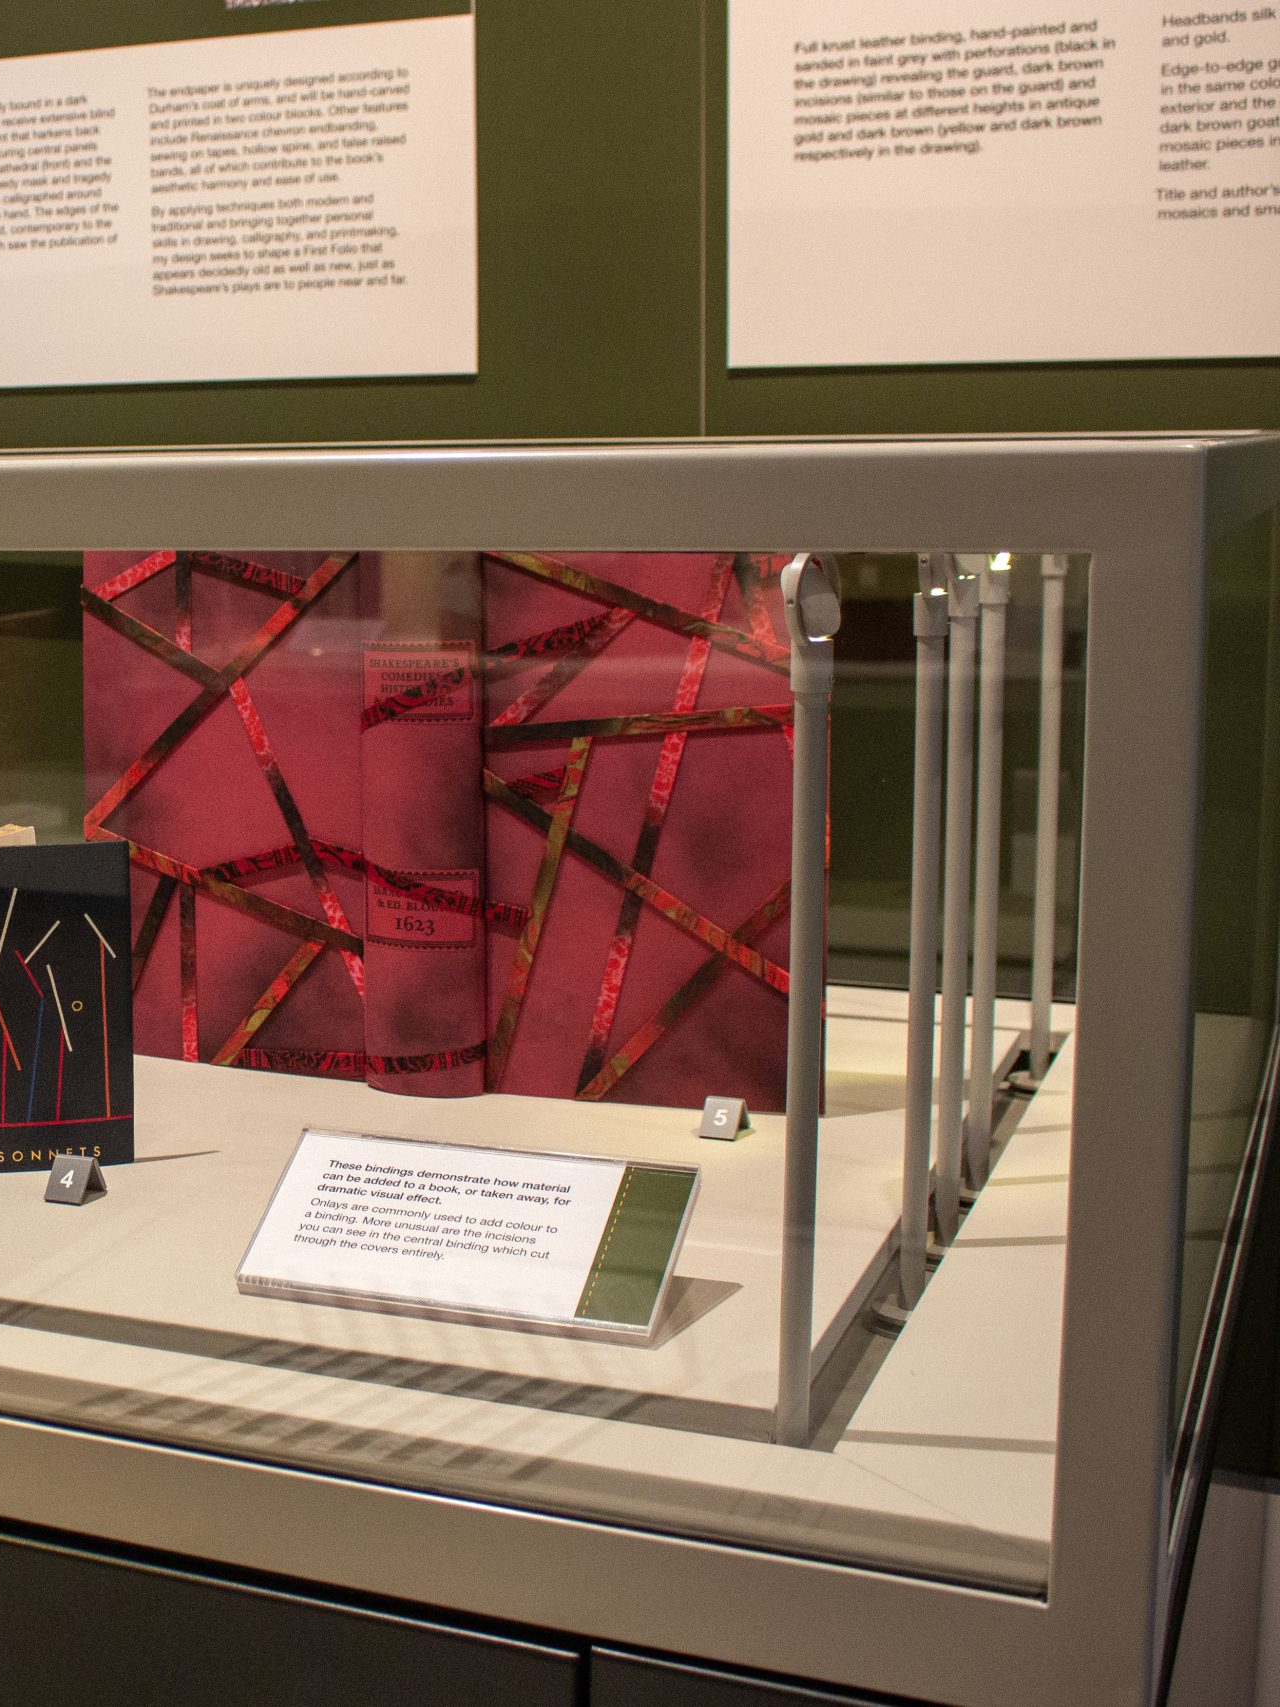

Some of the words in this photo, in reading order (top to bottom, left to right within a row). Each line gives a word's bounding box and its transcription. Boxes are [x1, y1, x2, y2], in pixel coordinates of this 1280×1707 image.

[1161, 8, 1248, 27] Headbands
[1251, 6, 1276, 22] silk
[1161, 32, 1190, 48] and
[1193, 29, 1230, 48] gold.
[1160, 58, 1264, 79] Edge-to-edge
[1160, 84, 1173, 95] in
[1177, 82, 1201, 95] the
[1204, 79, 1246, 93] same
[1159, 101, 1215, 115] exterior
[1218, 96, 1248, 112] and
[1251, 95, 1277, 109] the
[1159, 120, 1192, 134] dark
[1195, 118, 1243, 132] brown
[1159, 139, 1211, 152] mosaic
[1215, 136, 1265, 152] pieces
[1158, 157, 1210, 172] leather.
[1156, 187, 1186, 201] Title
[1189, 186, 1218, 200] and
[1157, 207, 1218, 220] mosaics
[1221, 202, 1251, 218] and
[395, 916, 435, 936] 1623
[714, 1109, 728, 1126] 5
[60, 1170, 74, 1188] 4
[329, 1159, 362, 1170] These
[364, 1163, 414, 1177] bindings
[416, 1169, 490, 1184] demonstrate
[493, 1177, 519, 1187] how
[521, 1182, 571, 1193] material
[316, 1183, 367, 1196] dramatic
[370, 1189, 404, 1200] visual
[405, 1193, 441, 1204] effect.
[322, 1172, 343, 1181] can
[345, 1173, 361, 1182] be
[363, 1176, 402, 1187] added
[403, 1180, 415, 1188] to
[428, 1182, 460, 1195] book,
[480, 1188, 513, 1199] taken
[515, 1194, 549, 1205] away,
[553, 1196, 571, 1206] for
[310, 1197, 348, 1210] Onlays
[350, 1203, 369, 1212] are
[371, 1206, 431, 1220] commonly
[433, 1213, 463, 1222] used
[465, 1215, 477, 1224] to
[479, 1218, 503, 1227] add
[505, 1221, 543, 1231] colour
[545, 1224, 558, 1234] to
[314, 1210, 357, 1224] binding.
[362, 1216, 392, 1227] More
[394, 1221, 440, 1233] unusual
[441, 1227, 460, 1235] are
[463, 1228, 482, 1238] the
[484, 1230, 536, 1244] incisions
[293, 1233, 337, 1247] through
[339, 1239, 358, 1249] the
[360, 1243, 398, 1254] covers
[401, 1248, 444, 1261] entirely.
[297, 1223, 320, 1231] you
[322, 1225, 343, 1234] can
[345, 1228, 366, 1237] see
[368, 1229, 379, 1239] in
[382, 1231, 401, 1241] the
[403, 1235, 444, 1246] central
[445, 1238, 489, 1254] binding
[492, 1245, 527, 1256] which
[530, 1250, 550, 1259] cut
